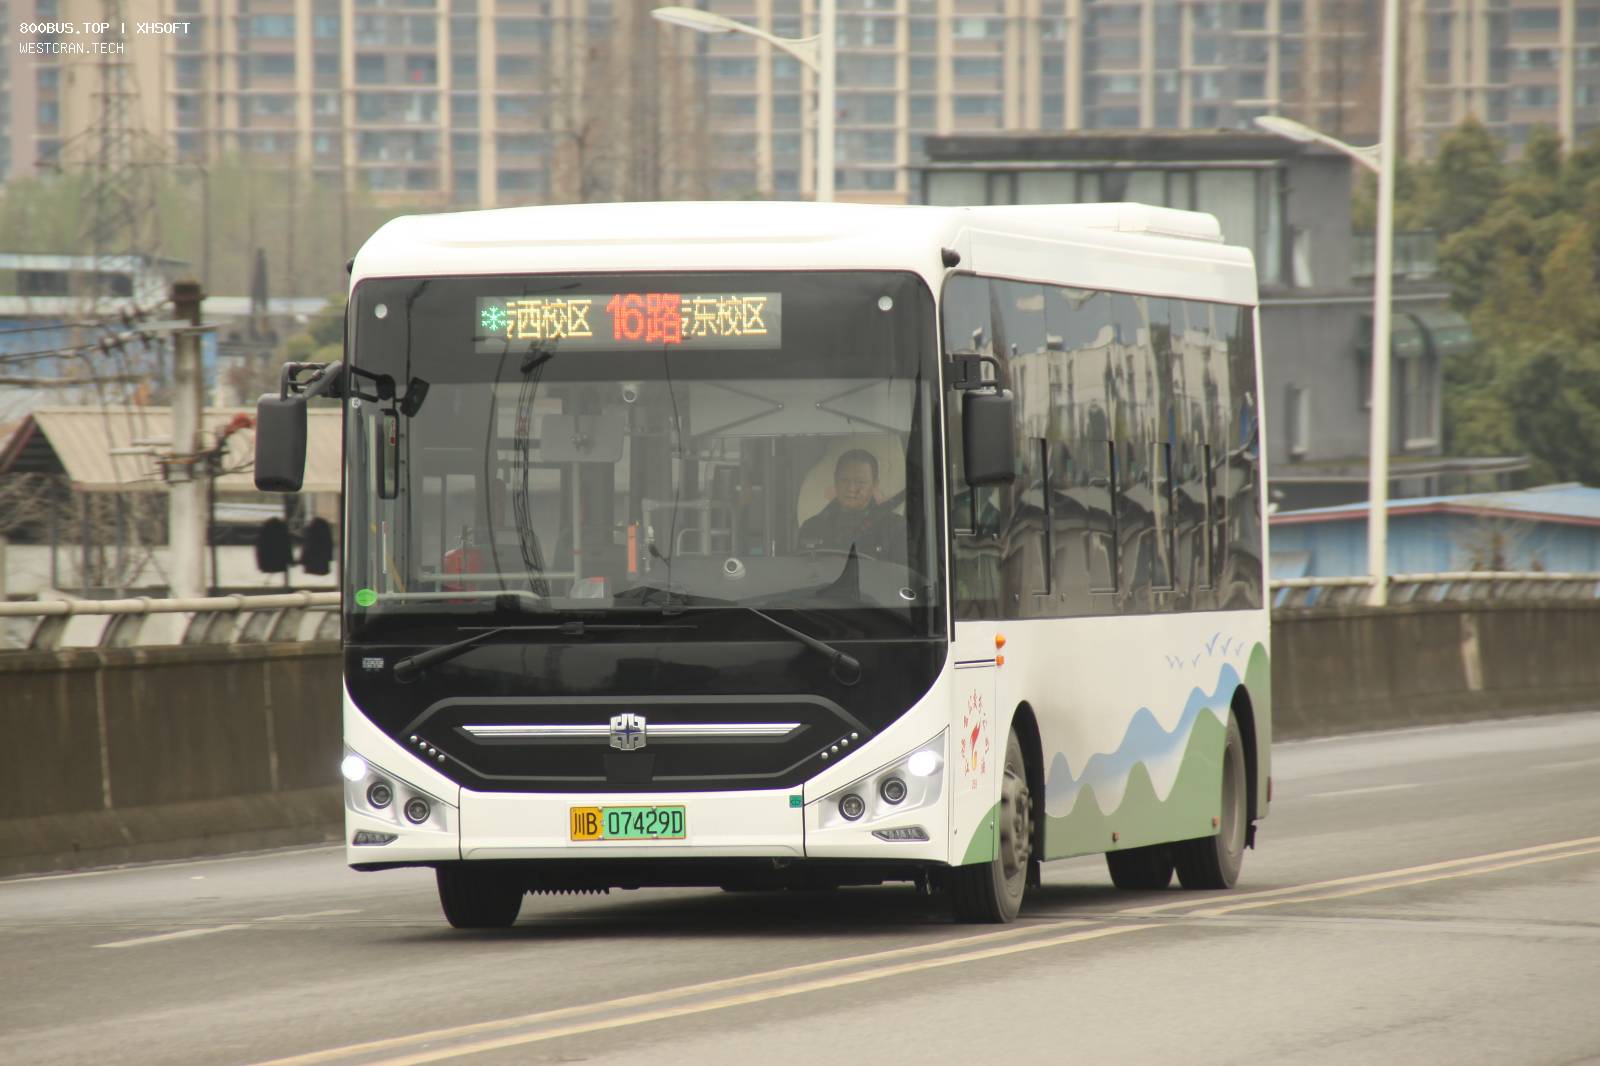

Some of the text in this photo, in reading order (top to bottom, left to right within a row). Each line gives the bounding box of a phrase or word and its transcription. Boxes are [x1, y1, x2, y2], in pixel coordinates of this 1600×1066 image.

[606, 293, 682, 344] 16路
[573, 810, 683, 836] 川B 07429D
